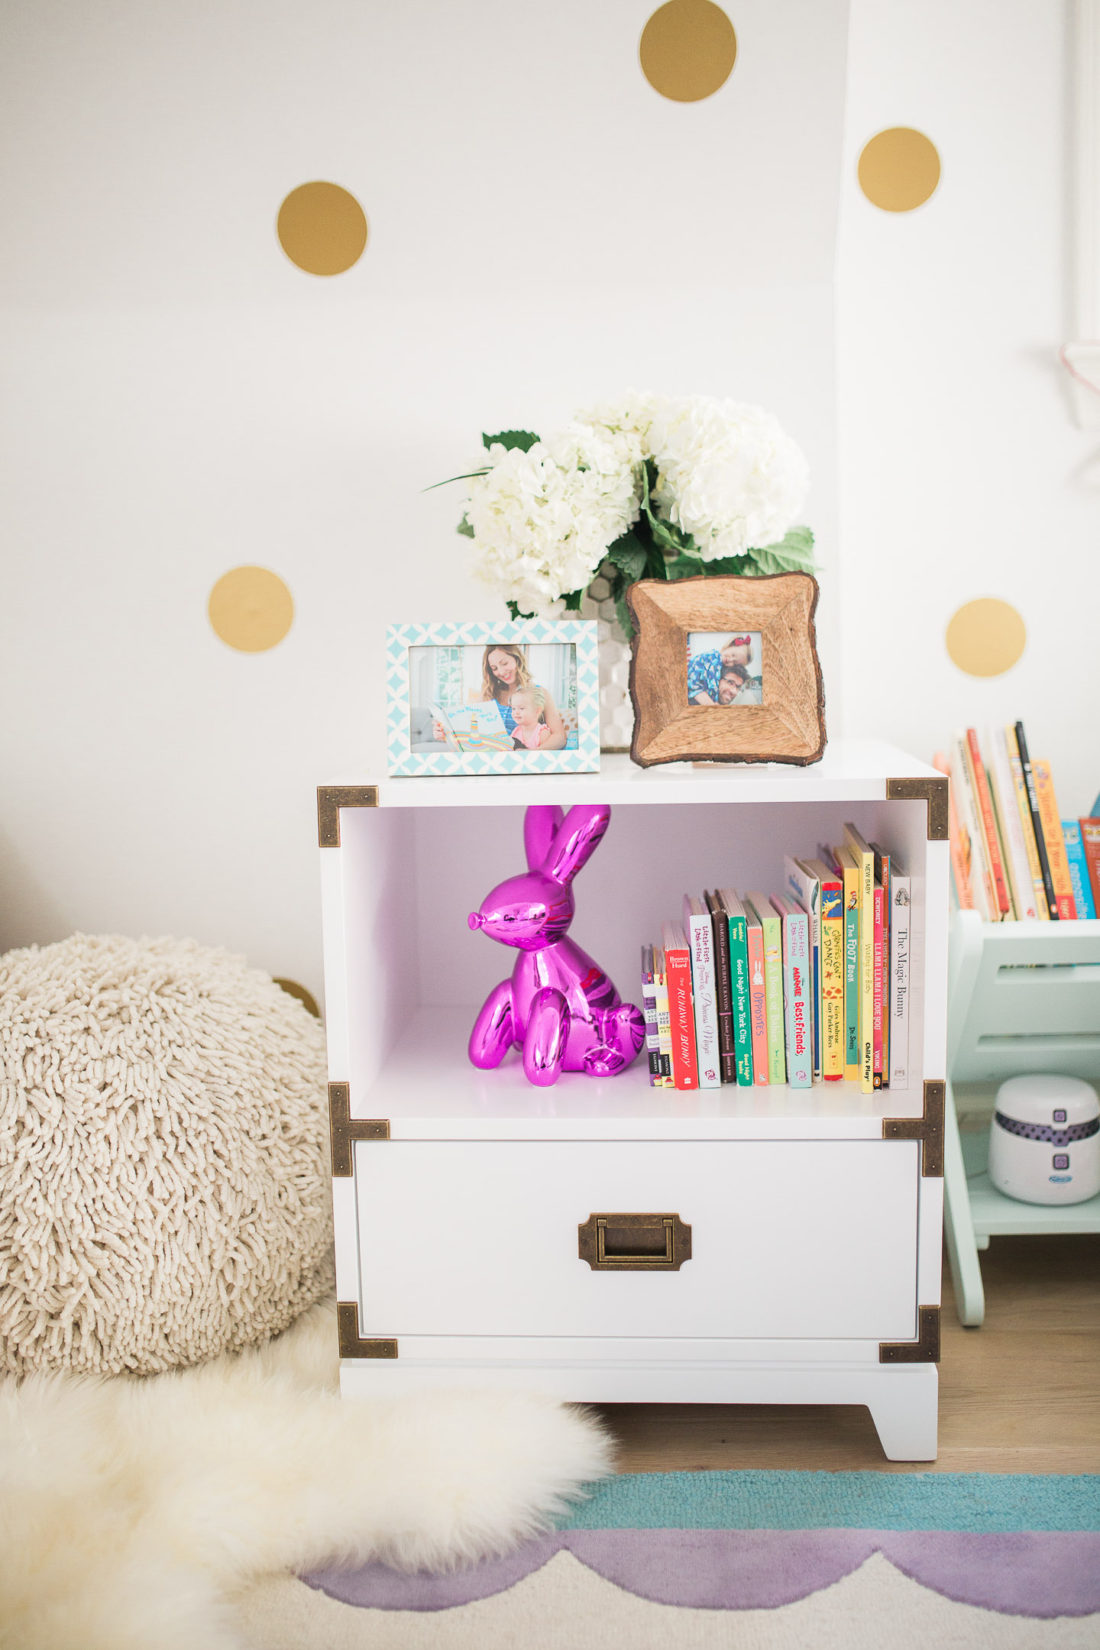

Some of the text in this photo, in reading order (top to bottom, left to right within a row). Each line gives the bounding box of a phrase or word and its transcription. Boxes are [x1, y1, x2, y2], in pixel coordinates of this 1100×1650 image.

[824, 939, 833, 967] DANCE
[847, 939, 857, 963] FOOT
[894, 928, 908, 1018] The Magic Bunny
[677, 988, 688, 1033] RUNAWAY
[736, 959, 747, 1044] Good Night New York City
[752, 992, 765, 1036] OPPOSITES
[792, 966, 806, 1055] MINNIE Best Friends
[680, 1034, 690, 1068] BUNNY
